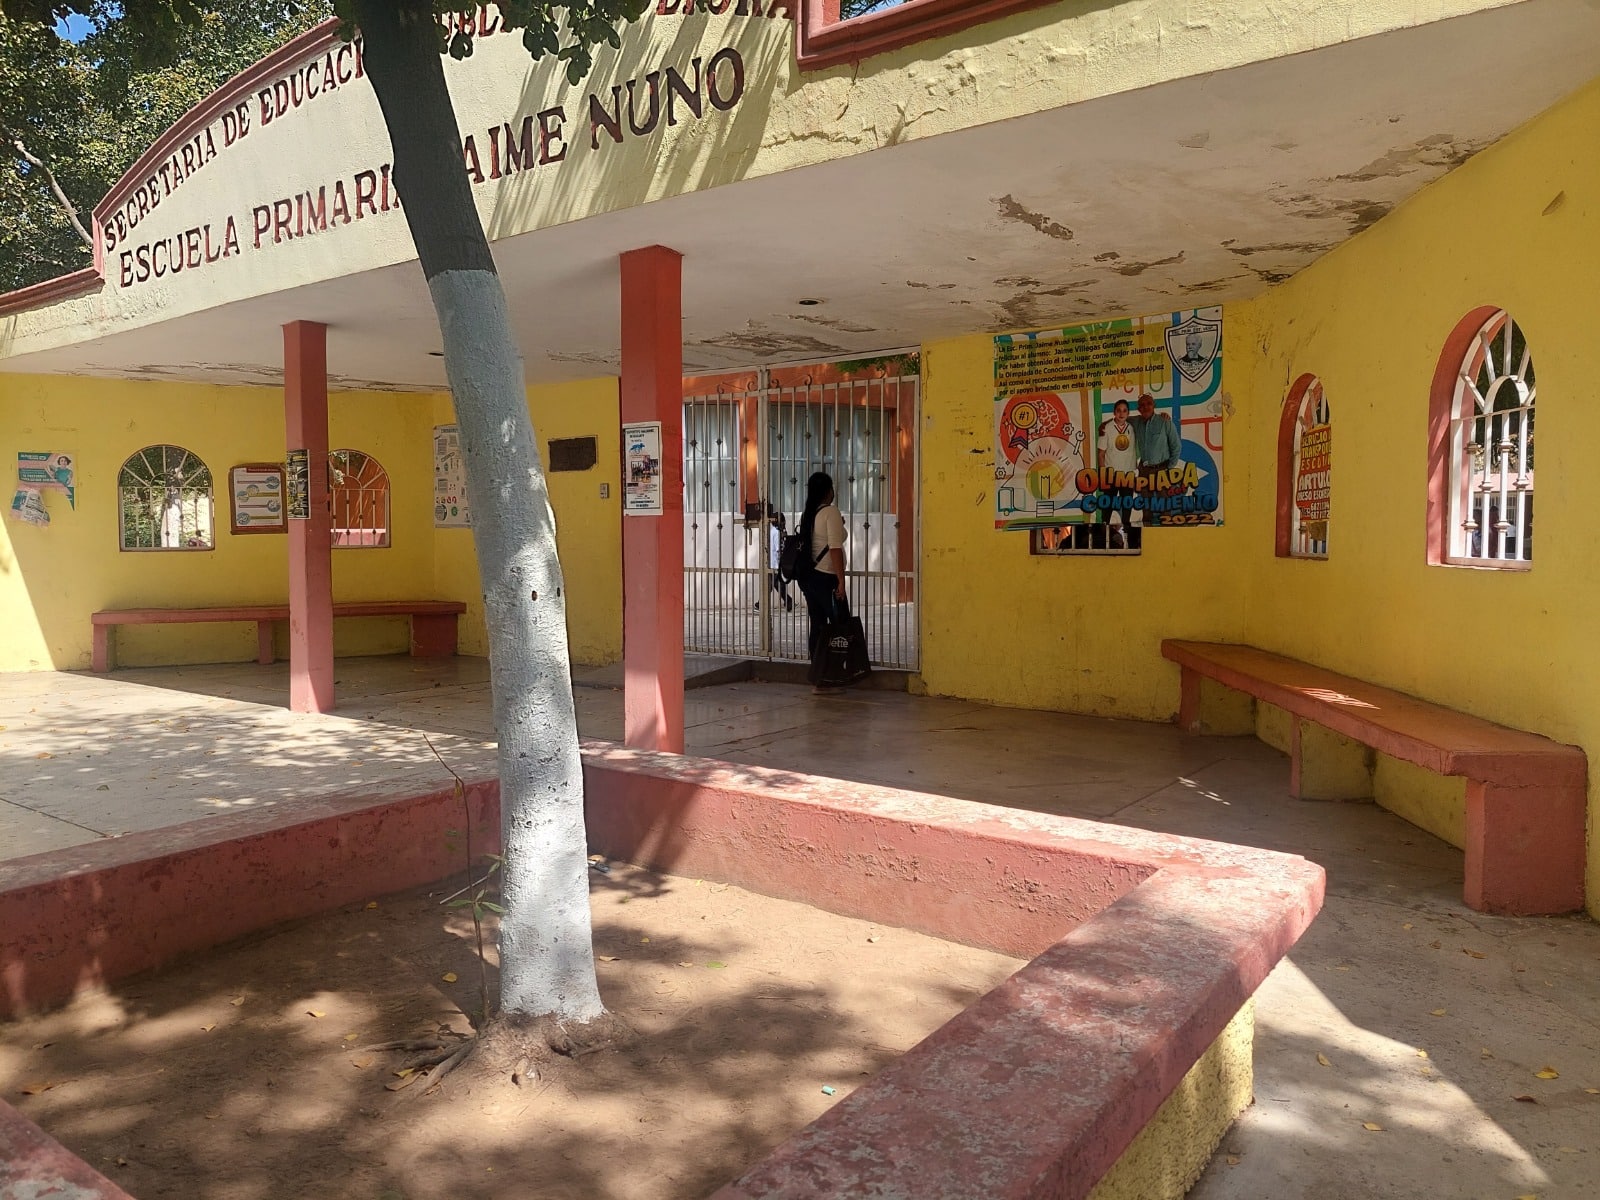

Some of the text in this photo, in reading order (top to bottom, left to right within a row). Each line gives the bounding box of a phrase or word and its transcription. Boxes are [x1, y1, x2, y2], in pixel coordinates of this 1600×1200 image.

[104, 38, 364, 253] SECRETARIA DE EDUCACI
[120, 214, 241, 289] ESCUELA
[252, 163, 400, 250] PRIMARI
[463, 105, 567, 185] AIME
[1032, 374, 1078, 384] reconocimiento
[1044, 364, 1084, 374] Conocimiento
[1076, 462, 1198, 494] OLIMPIADA
[1080, 492, 1218, 513] CONOCIMIENTO
[1160, 514, 1215, 525] 2022
